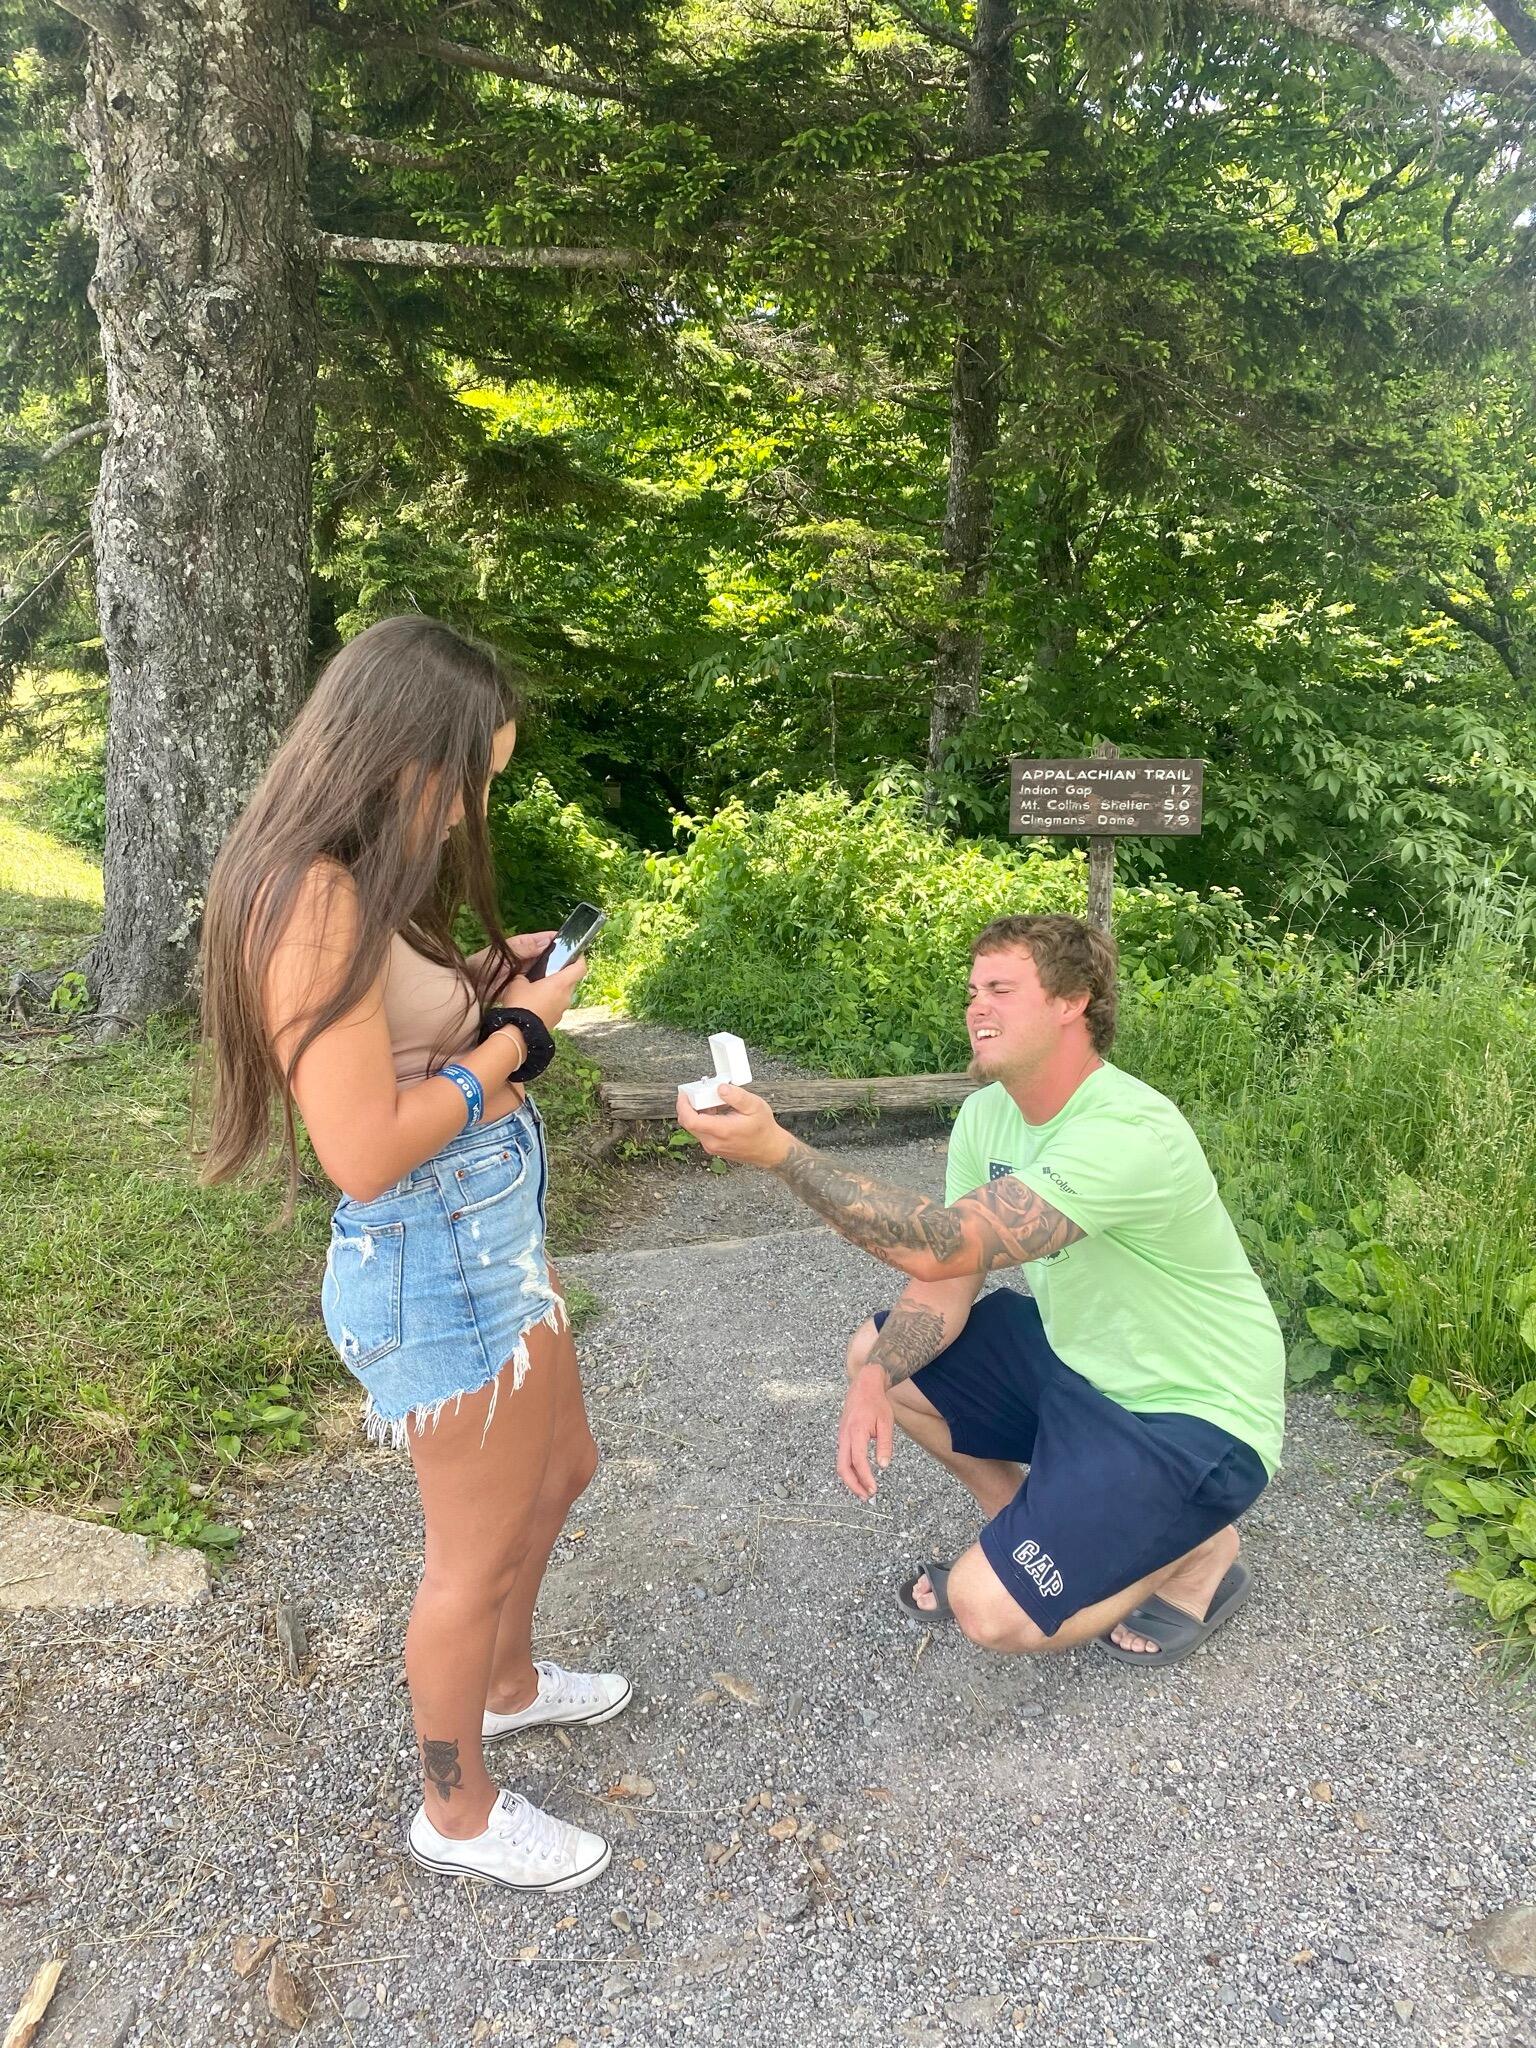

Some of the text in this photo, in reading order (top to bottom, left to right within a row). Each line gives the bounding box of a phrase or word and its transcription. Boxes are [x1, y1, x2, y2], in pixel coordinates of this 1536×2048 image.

[1021, 769, 1192, 781] APPALACHIAN TRAIL
[1019, 785, 1058, 795] Indian
[1066, 785, 1092, 798] Gap
[1020, 800, 1040, 810] Mt.
[1100, 799, 1149, 810] Shelter
[1163, 799, 1190, 811] 5.0
[1020, 814, 1086, 827] Clingmans
[1097, 815, 1135, 825] Dome
[1012, 1540, 1063, 1597] GAP
